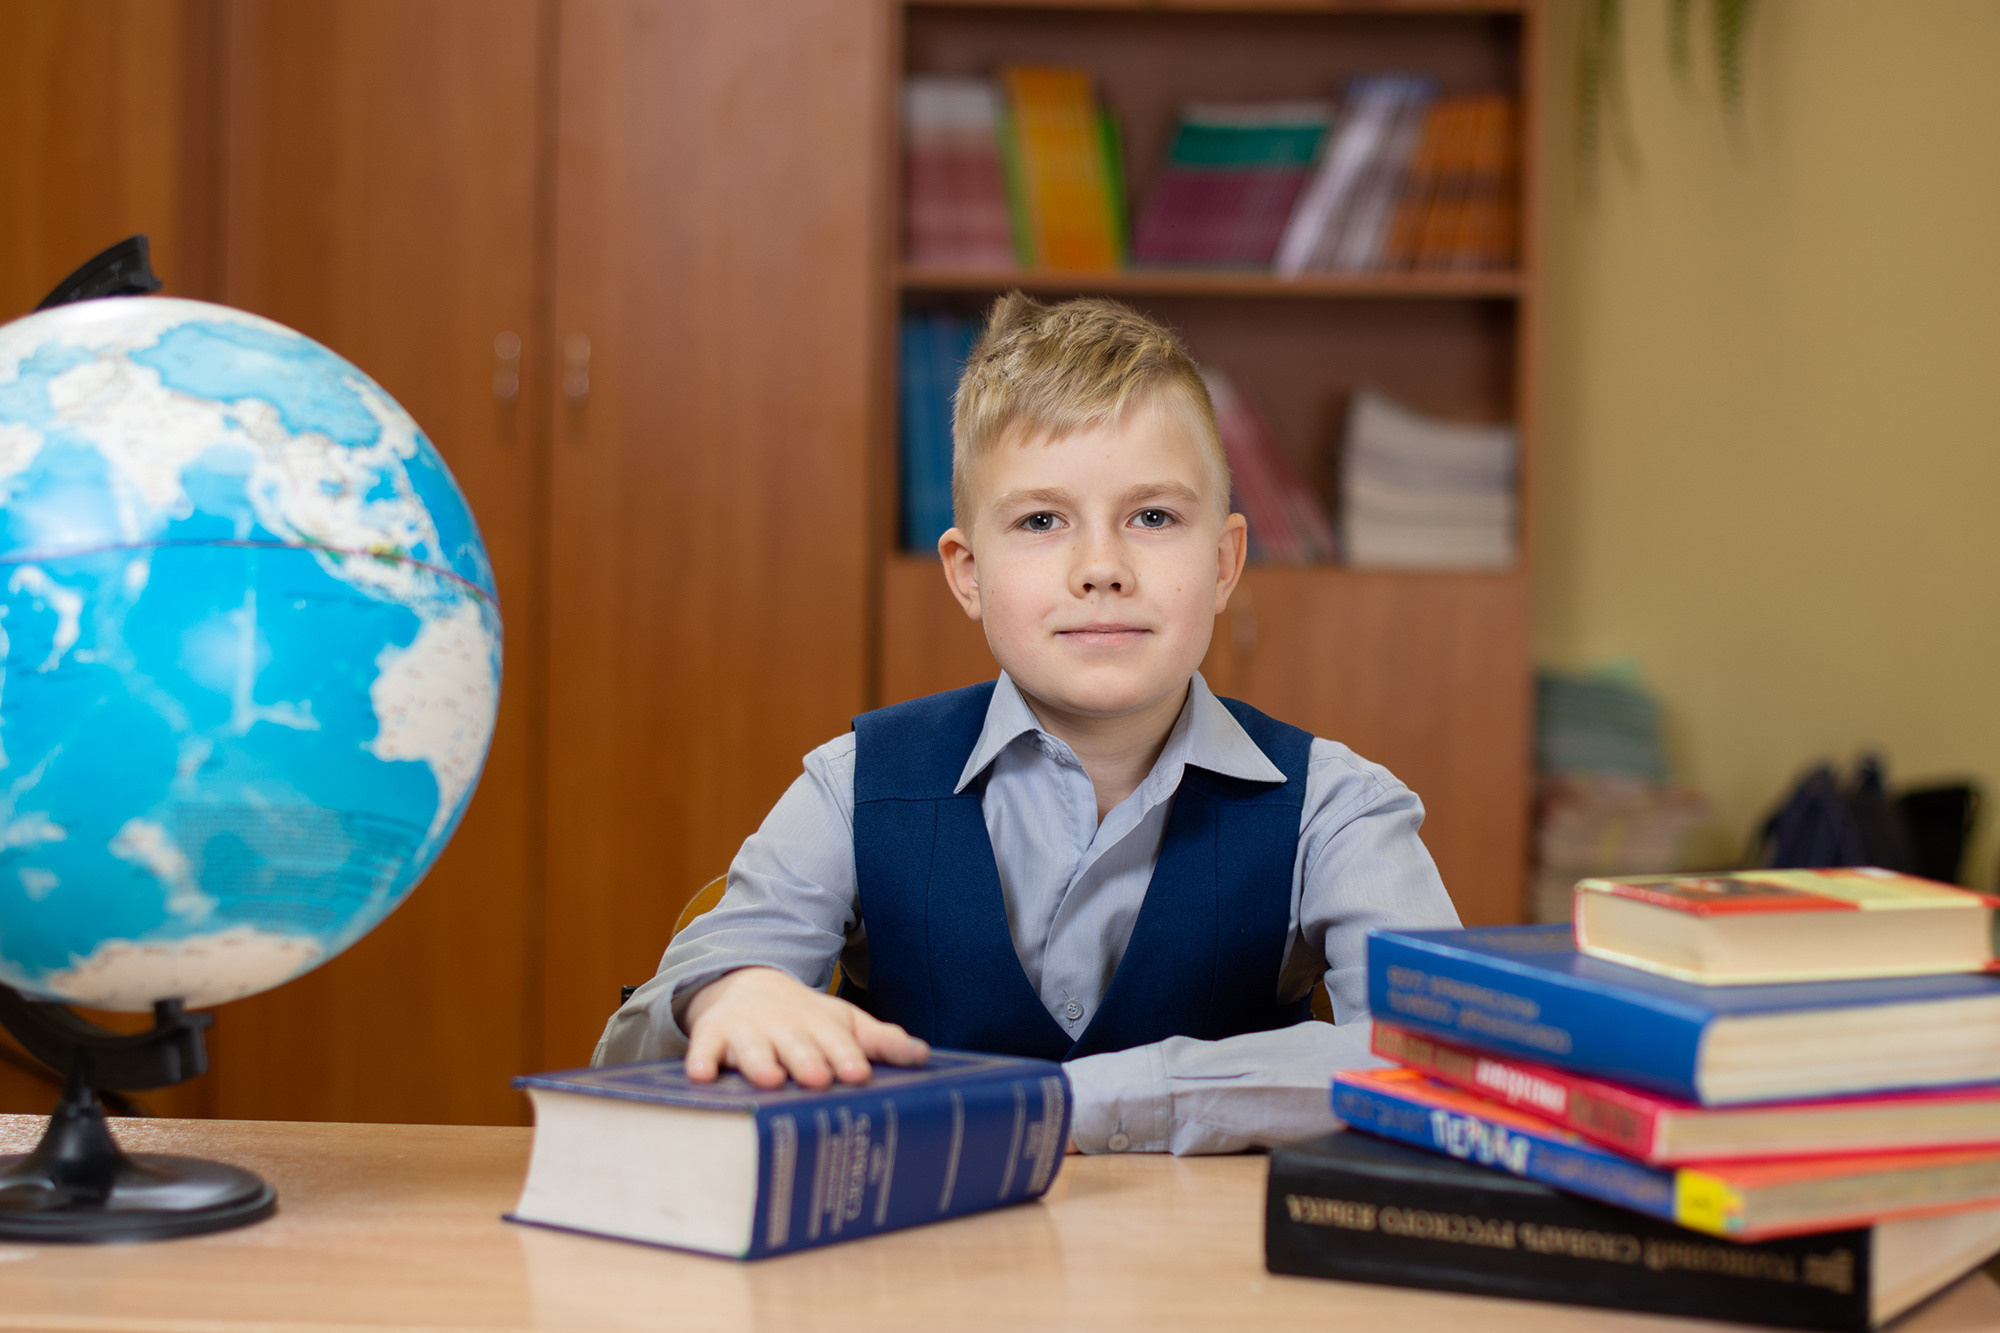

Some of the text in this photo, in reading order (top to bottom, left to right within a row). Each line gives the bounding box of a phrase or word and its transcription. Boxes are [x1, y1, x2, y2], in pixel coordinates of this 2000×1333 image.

[1286, 1194, 1377, 1232] ЯЗЫКА
[1378, 1205, 1516, 1249] РУССКОГО
[1517, 1222, 1641, 1264] СЛОВАРЬ
